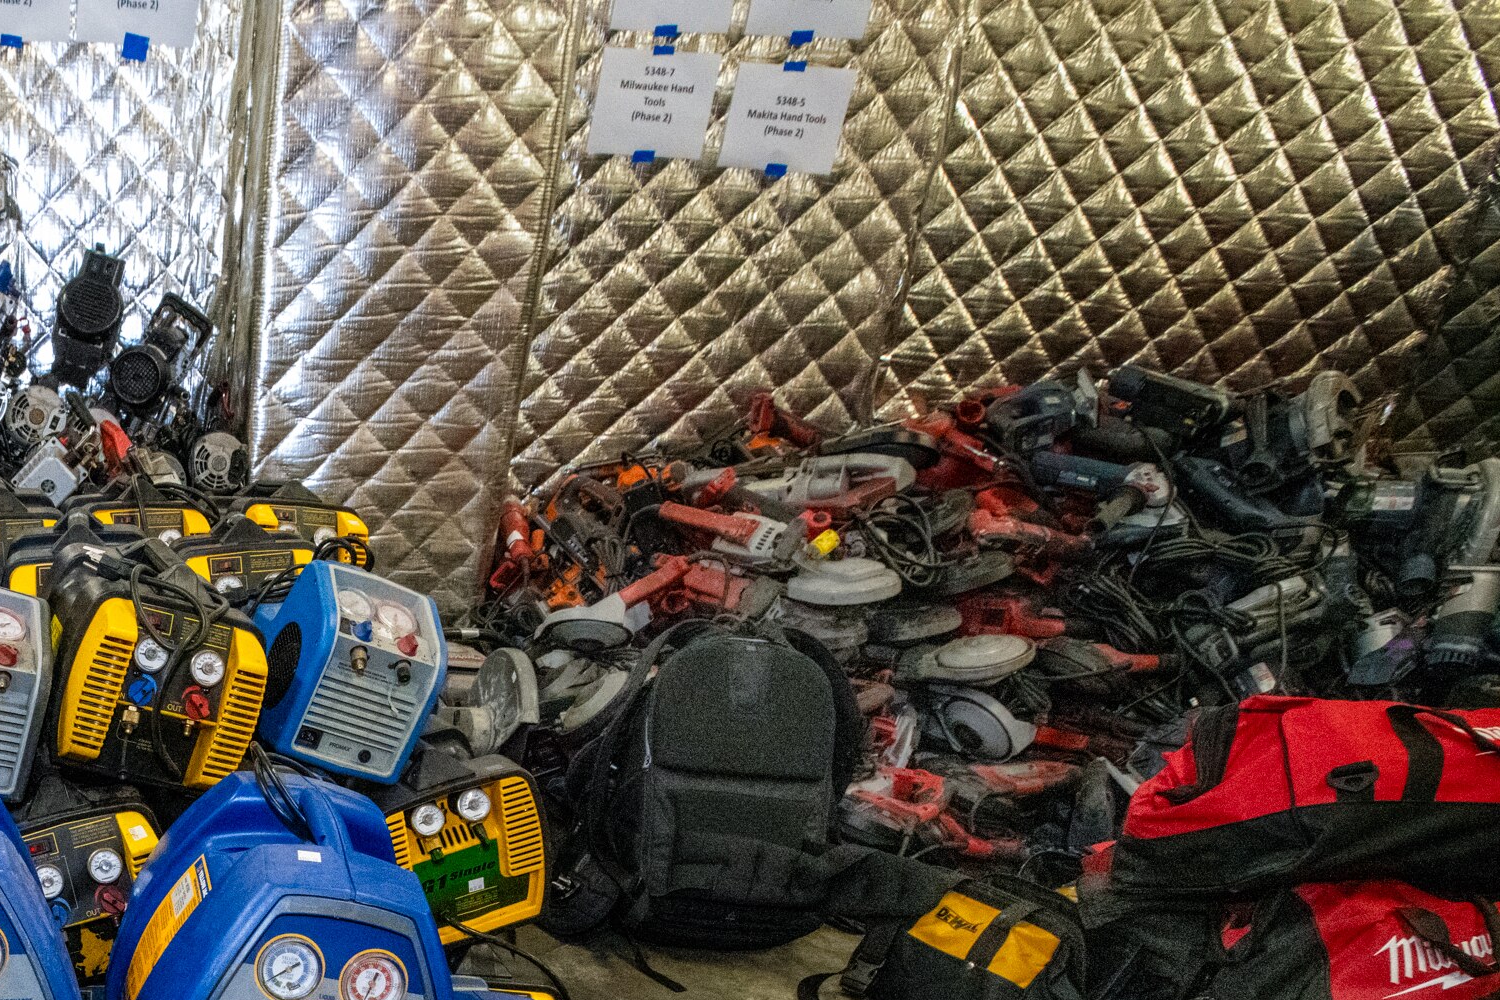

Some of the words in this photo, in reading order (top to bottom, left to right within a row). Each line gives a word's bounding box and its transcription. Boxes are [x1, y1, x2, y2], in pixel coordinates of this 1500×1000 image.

[117, 0, 147, 9] (Phase
[150, 1, 159, 11] 2)
[644, 66, 675, 77] 5348-7
[620, 80, 669, 93] Milwaukee
[670, 83, 694, 94] Hand
[644, 97, 665, 107] Tools
[776, 95, 806, 107] 5348-5
[631, 111, 661, 123] (Phase
[663, 113, 672, 124] 2)
[747, 109, 778, 121] Makita
[780, 112, 802, 123] Hand
[804, 114, 827, 125] Tools
[763, 126, 794, 138] (Phase
[795, 127, 804, 139] 2)
[166, 703, 183, 712] OUT
